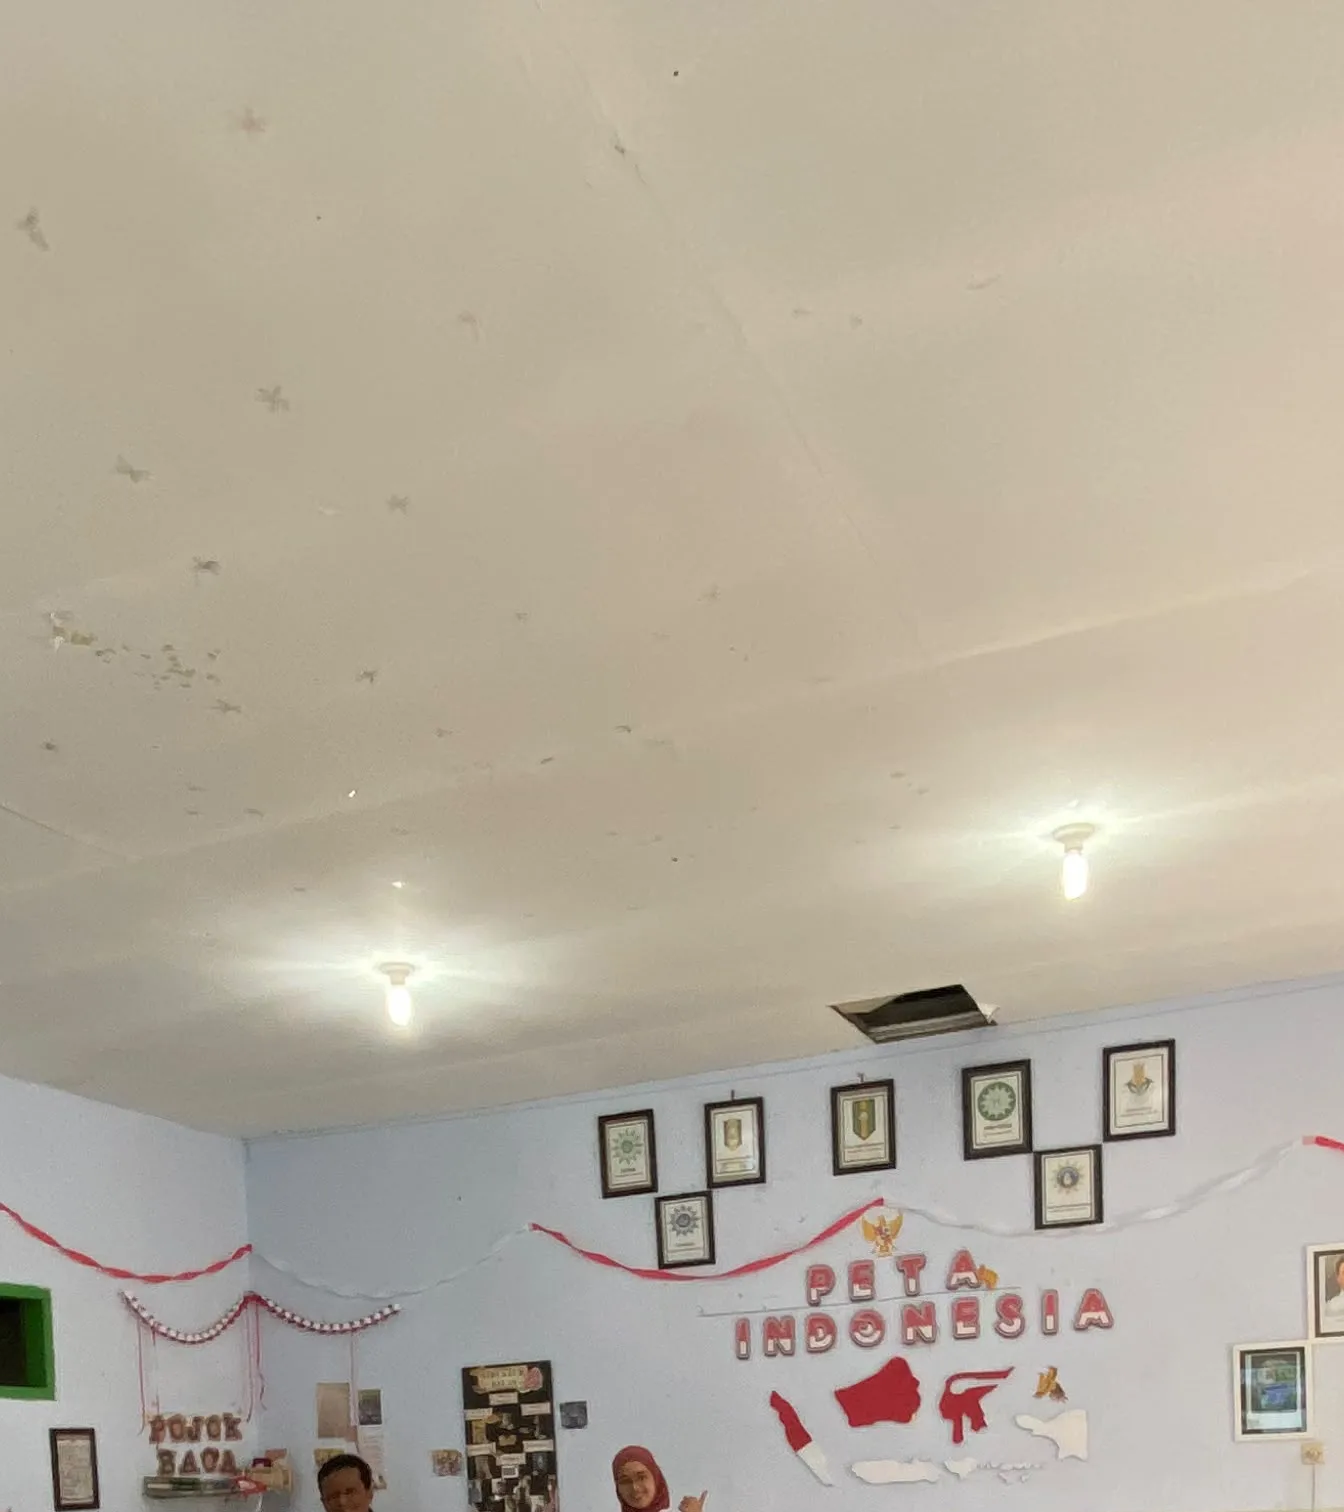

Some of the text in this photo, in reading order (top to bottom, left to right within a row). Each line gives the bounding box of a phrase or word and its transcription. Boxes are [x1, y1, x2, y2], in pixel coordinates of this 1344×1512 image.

[805, 1248, 981, 1307] PETA
[733, 1287, 1115, 1360] INDONESIA
[147, 1411, 243, 1445] POJOK
[157, 1446, 239, 1476] BACA
